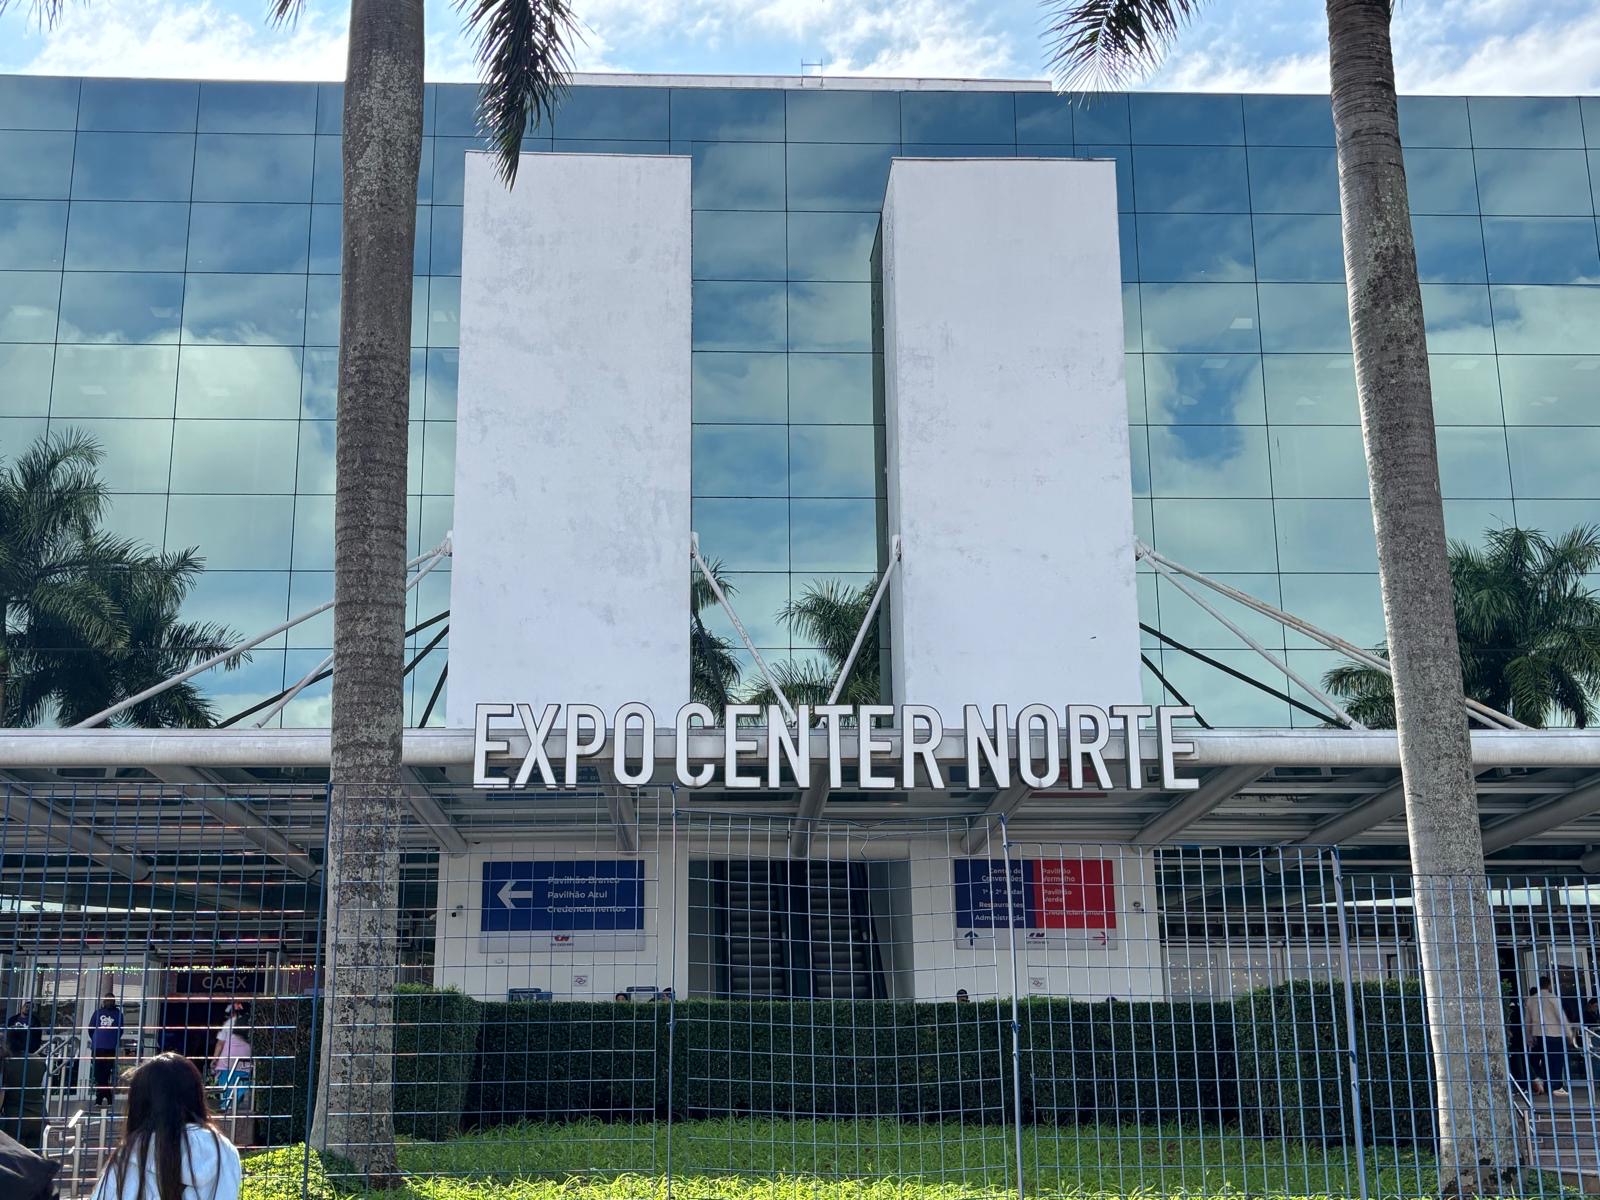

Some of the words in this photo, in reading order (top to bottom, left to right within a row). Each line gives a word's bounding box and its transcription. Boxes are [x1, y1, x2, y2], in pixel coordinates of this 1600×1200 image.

[472, 702, 656, 790] EXPO
[675, 702, 945, 790] CENTER
[965, 703, 1200, 791] NORTE
[548, 876, 586, 884] Pavilhão
[202, 976, 247, 989] CAEX
